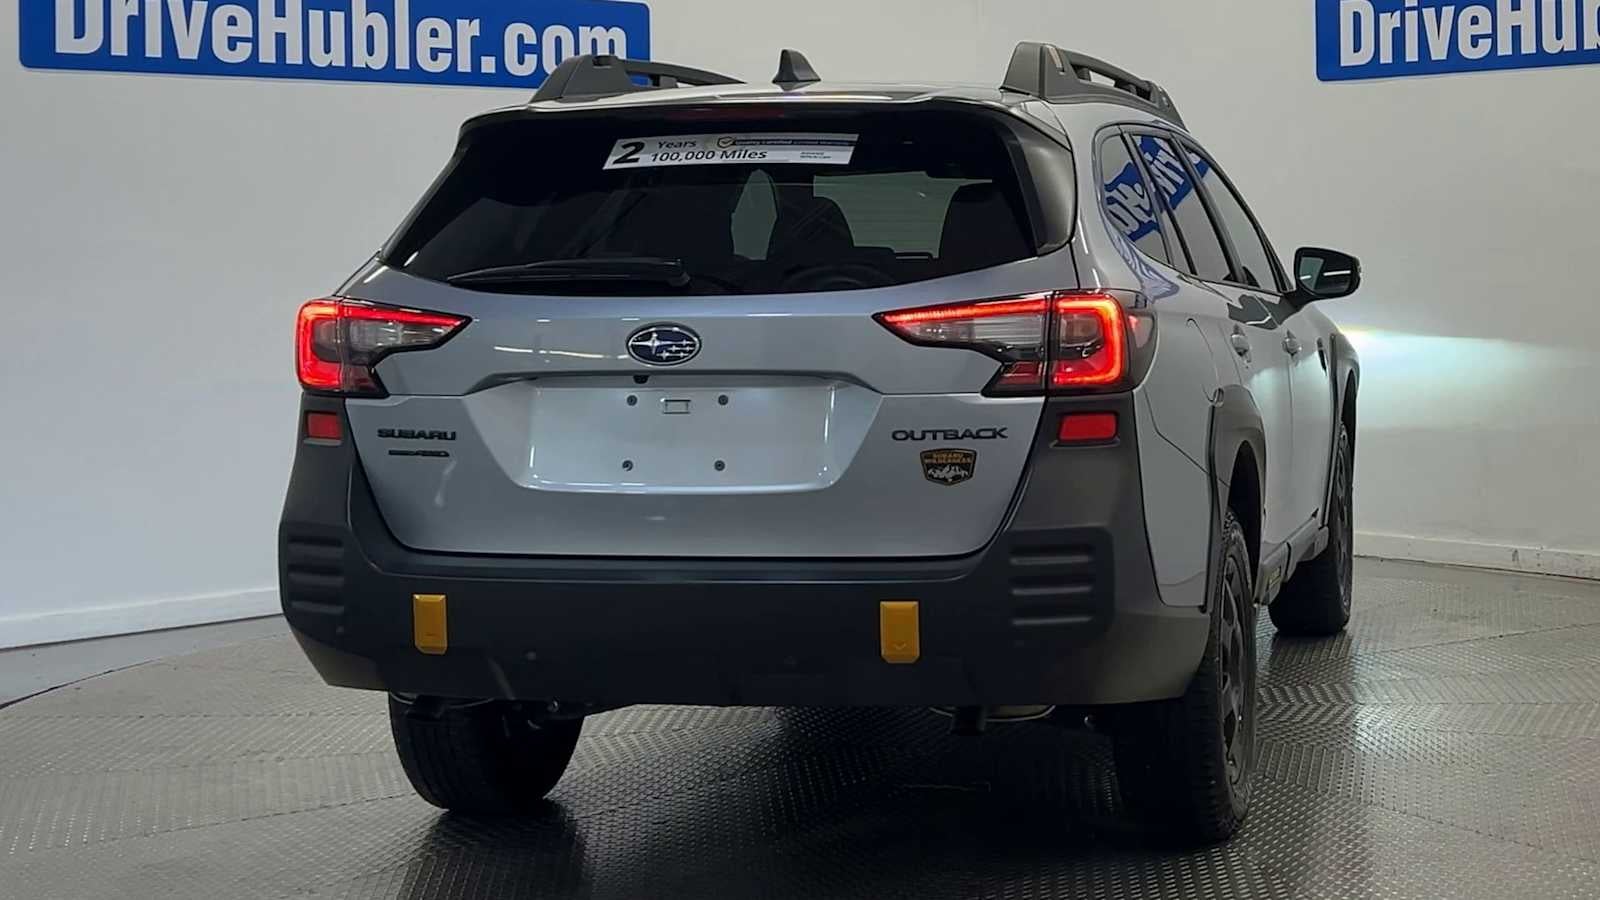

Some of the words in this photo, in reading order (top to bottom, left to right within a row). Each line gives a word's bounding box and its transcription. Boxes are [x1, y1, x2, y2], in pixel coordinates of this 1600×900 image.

[55, 0, 627, 76] DriveHubler.com
[612, 142, 645, 164] 2
[658, 141, 697, 149] Years
[651, 151, 715, 162] 100,000
[720, 150, 768, 159] Miles
[377, 429, 456, 440] SUBARU
[892, 427, 1008, 441] OUTBACK
